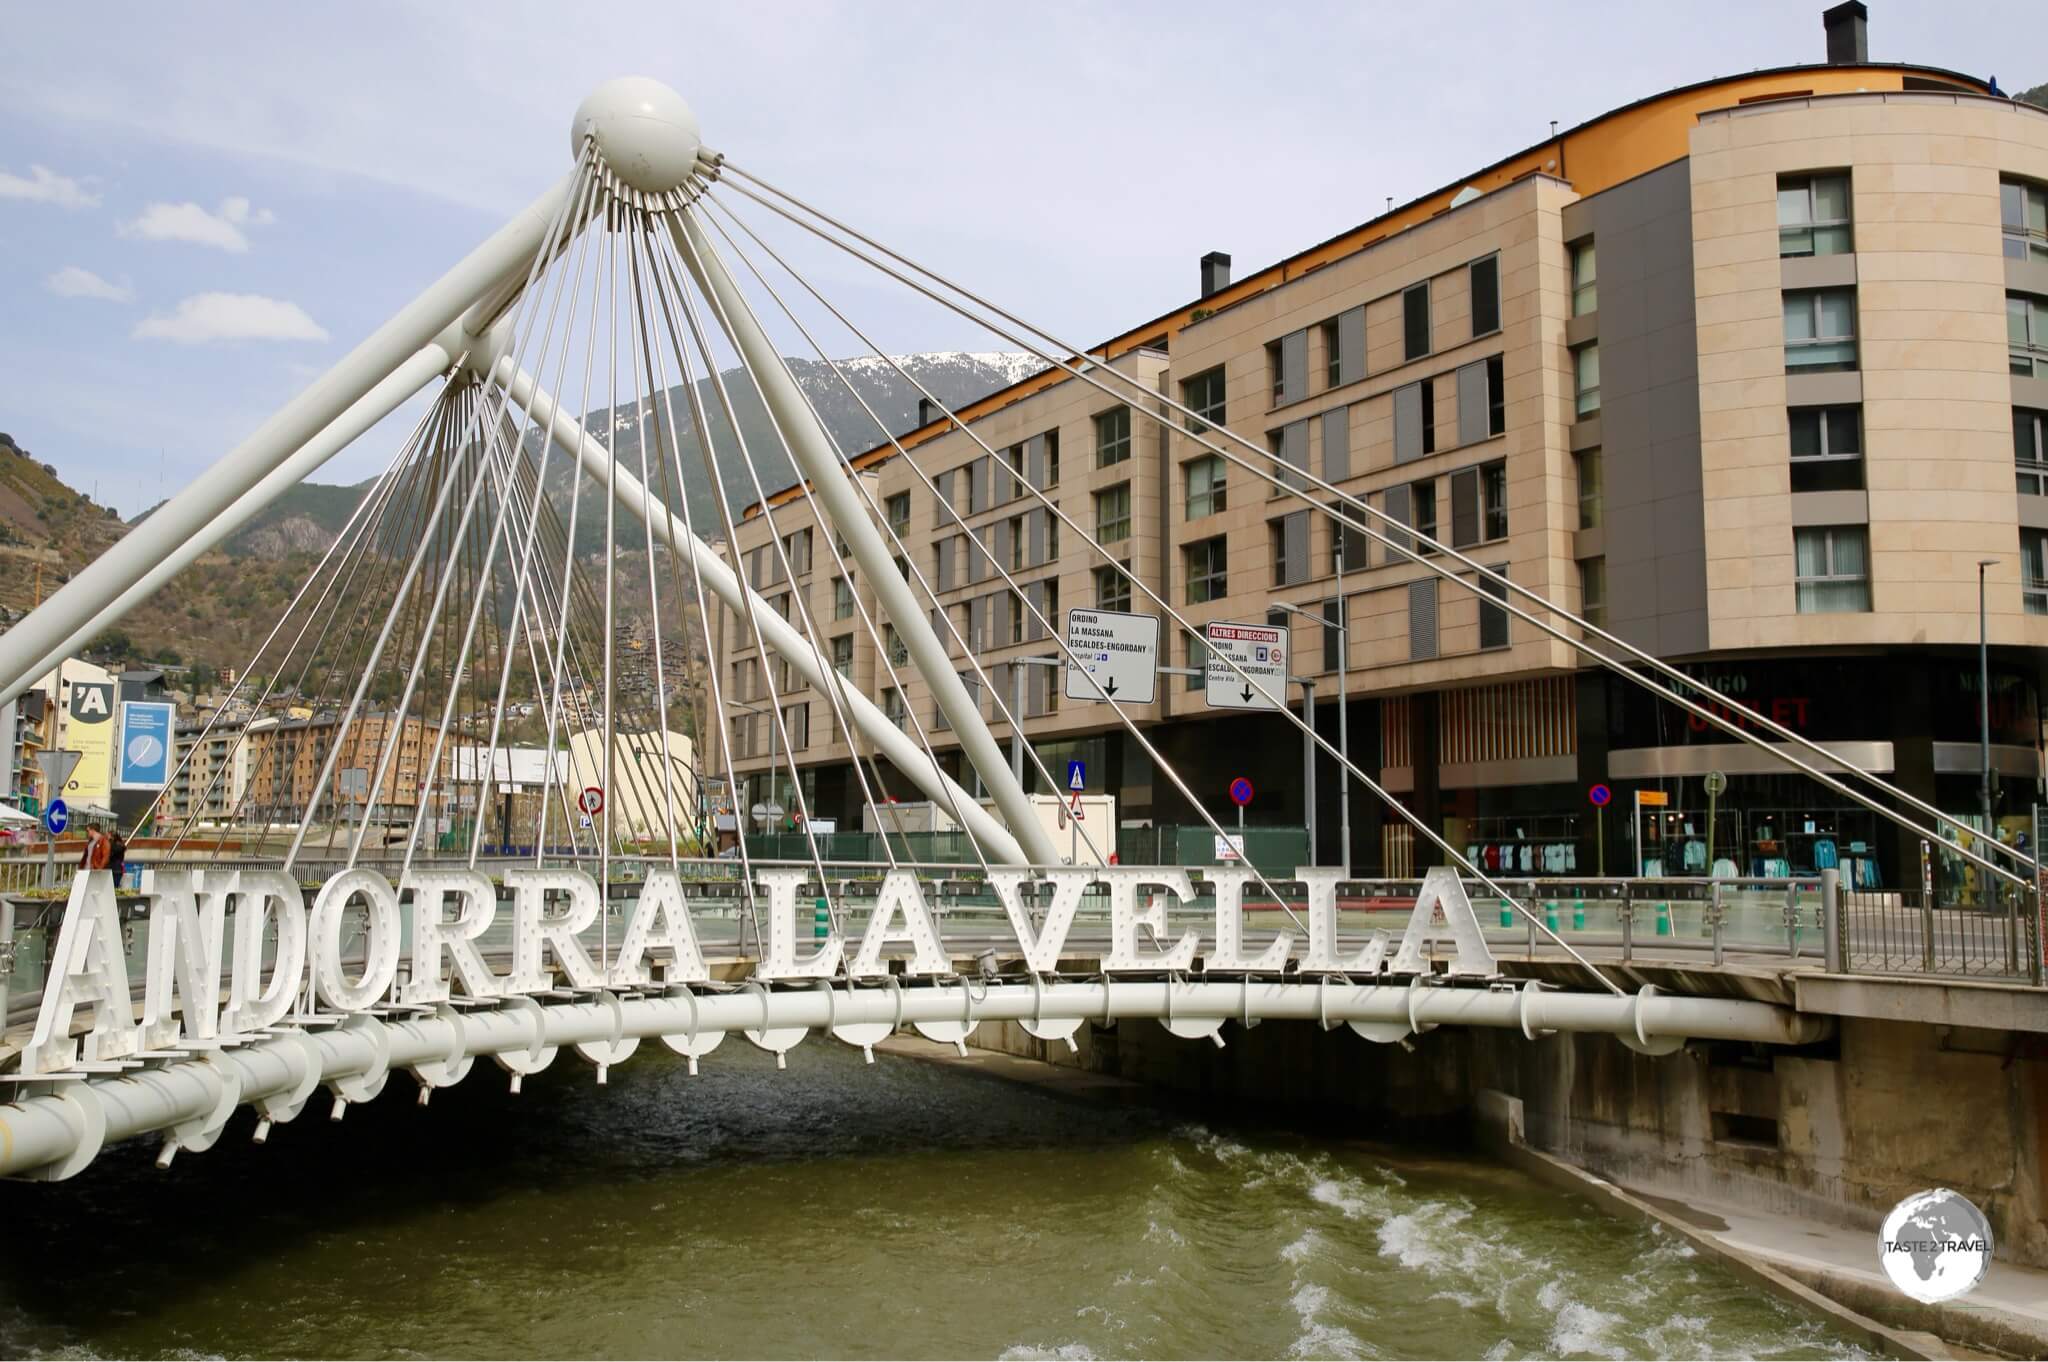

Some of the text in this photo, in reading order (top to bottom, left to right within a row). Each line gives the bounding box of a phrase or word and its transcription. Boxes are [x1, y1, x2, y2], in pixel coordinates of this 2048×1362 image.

[1072, 614, 1098, 624] ORDINO
[1071, 626, 1114, 638] LA MASSANA
[1211, 628, 1277, 642] ALTRES DIRECCIONS
[1070, 639, 1147, 653] ESCALDES-ENGORDANY
[1209, 652, 1248, 663] LA SSANA
[1208, 663, 1275, 676] ESCALDENGORDANY
[23, 865, 1500, 1074] ANDORRA LA VELLA
